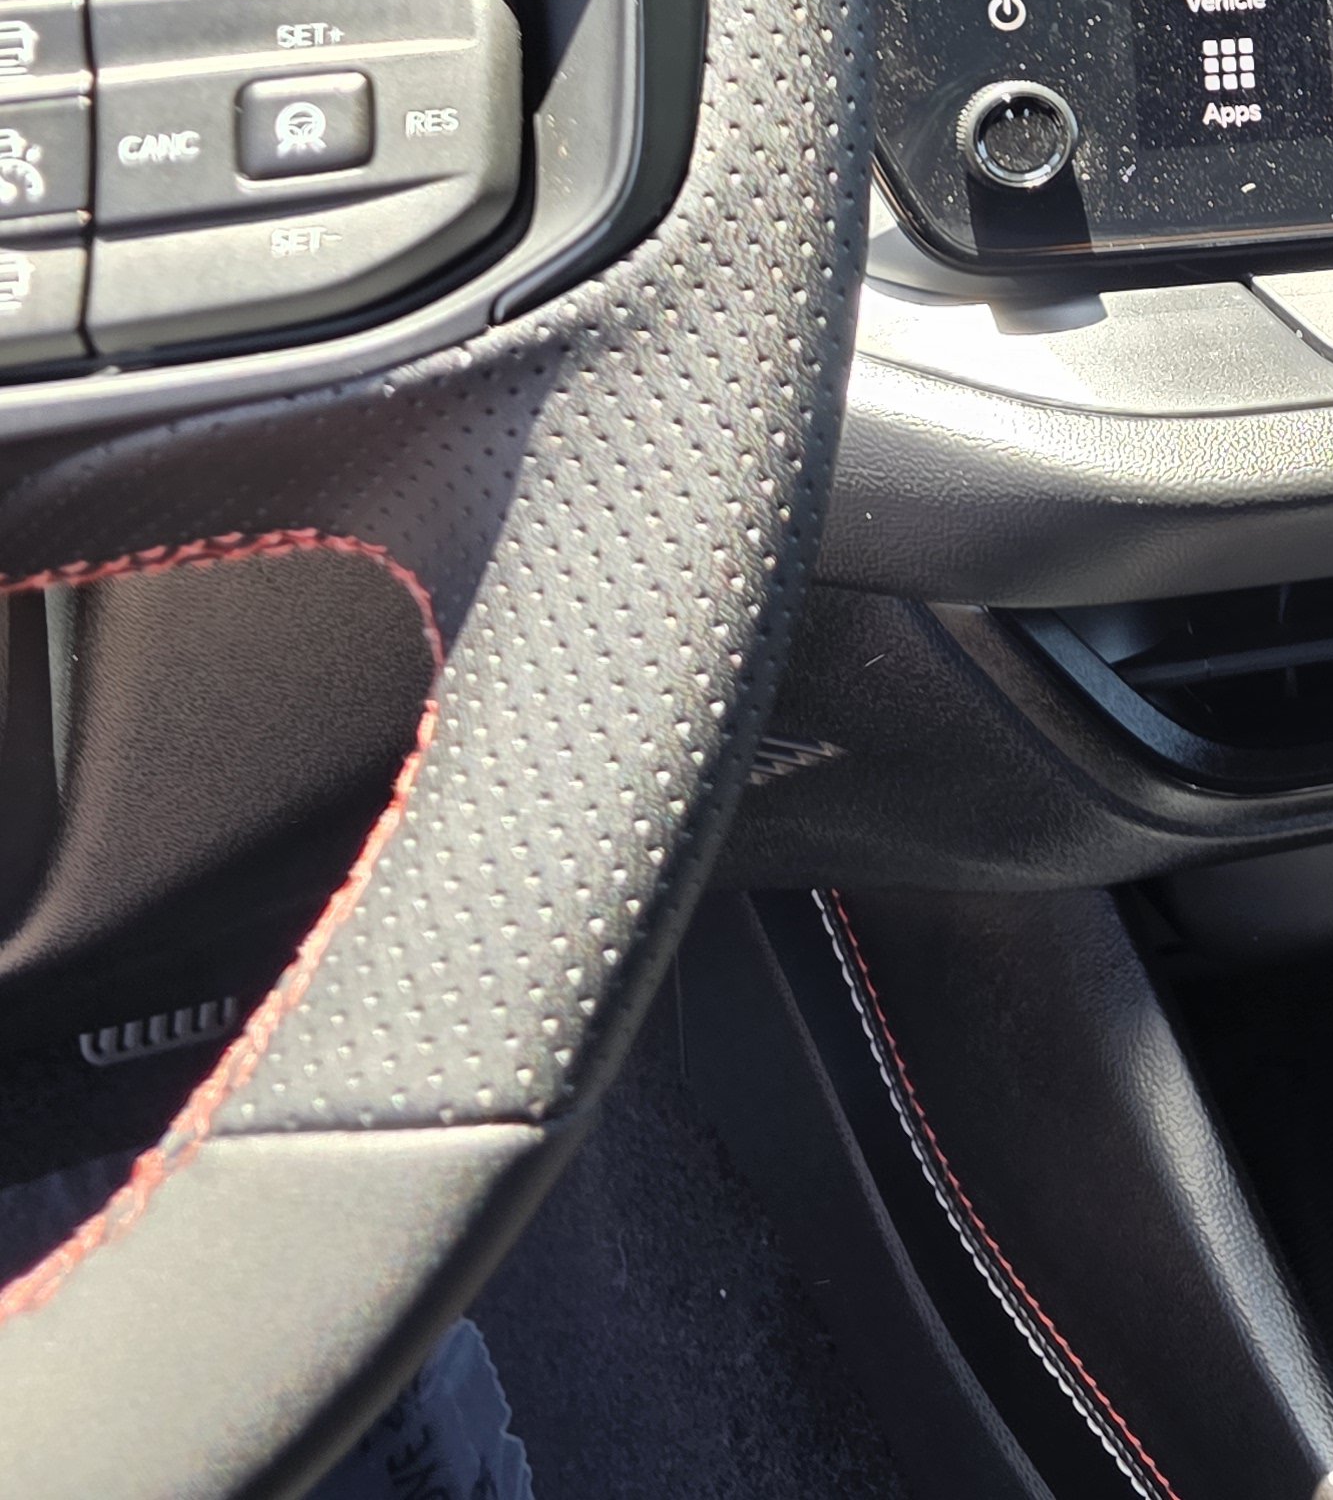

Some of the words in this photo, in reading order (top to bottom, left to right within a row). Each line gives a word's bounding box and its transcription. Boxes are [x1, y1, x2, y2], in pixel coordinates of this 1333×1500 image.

[277, 23, 344, 48] SET+
[405, 107, 458, 137] RES
[1203, 102, 1261, 128] Apps
[119, 131, 199, 165] CANC
